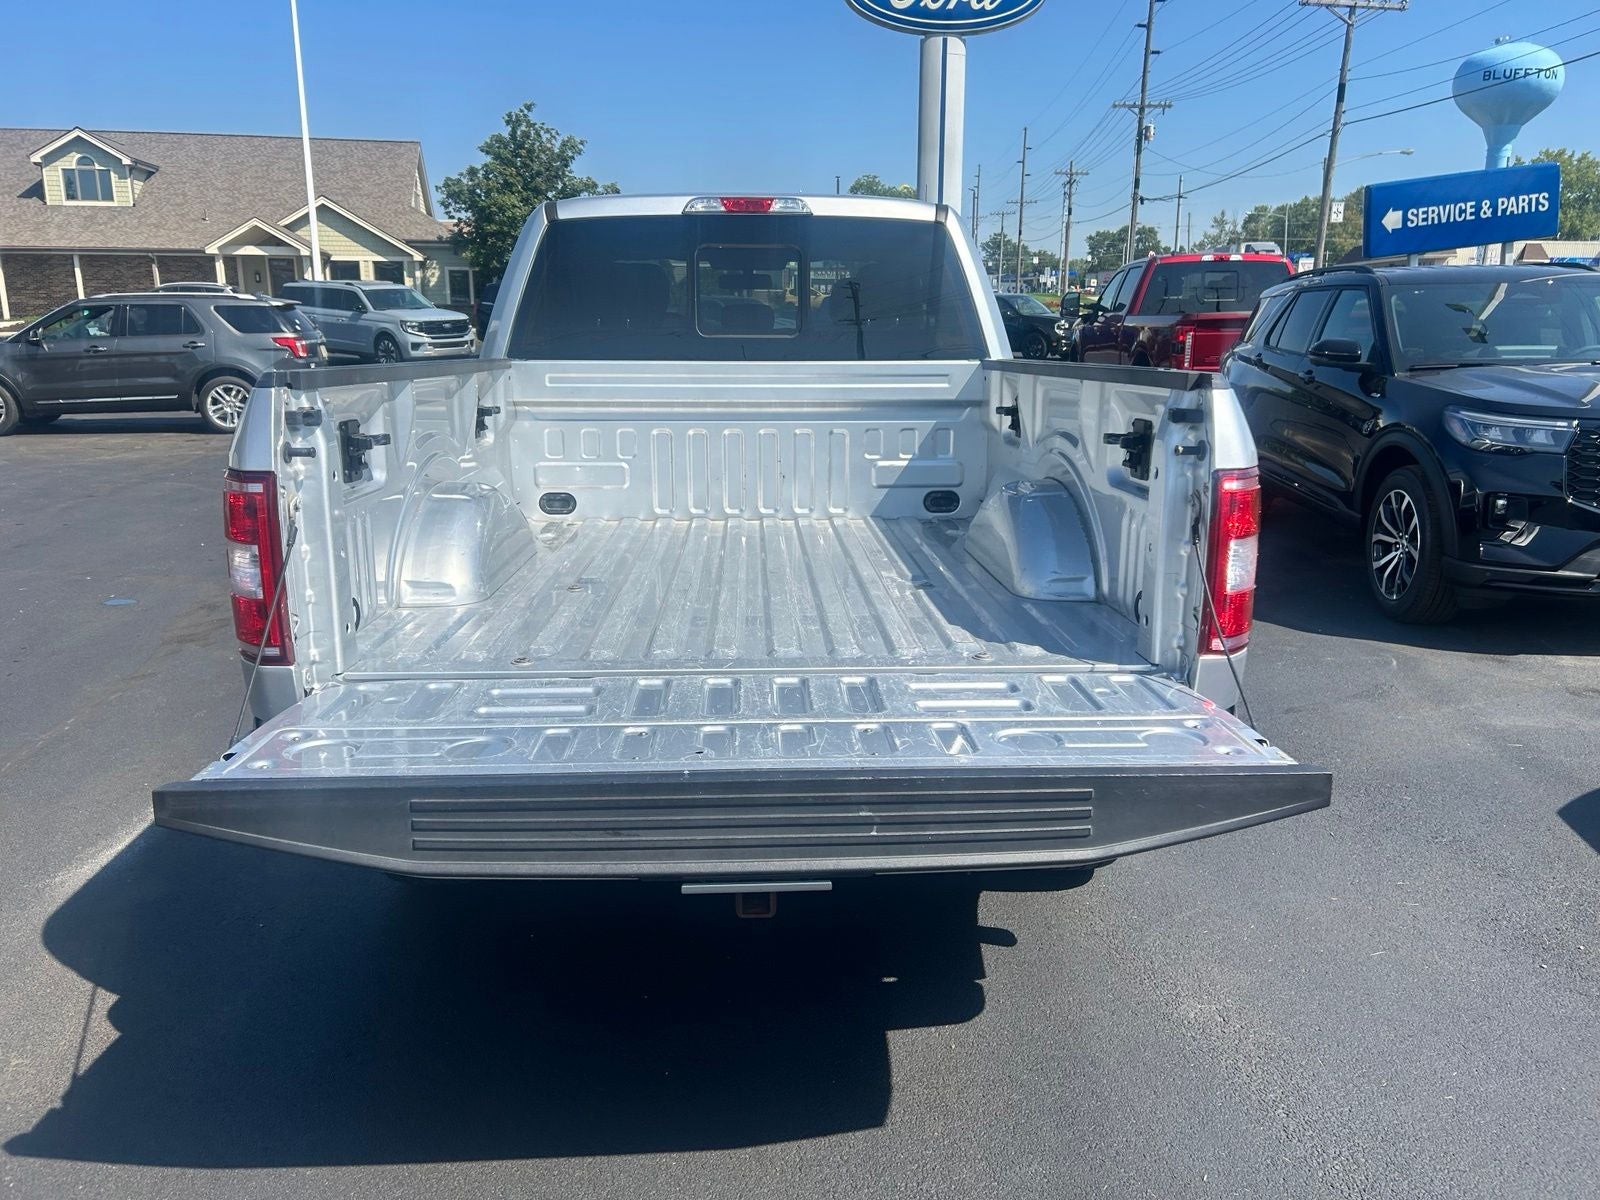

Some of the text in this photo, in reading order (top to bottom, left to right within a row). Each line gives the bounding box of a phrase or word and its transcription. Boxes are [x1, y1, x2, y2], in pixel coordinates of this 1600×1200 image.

[1482, 67, 1558, 81] BLUFFTON
[1407, 192, 1549, 228] SERVICE & PARTS
